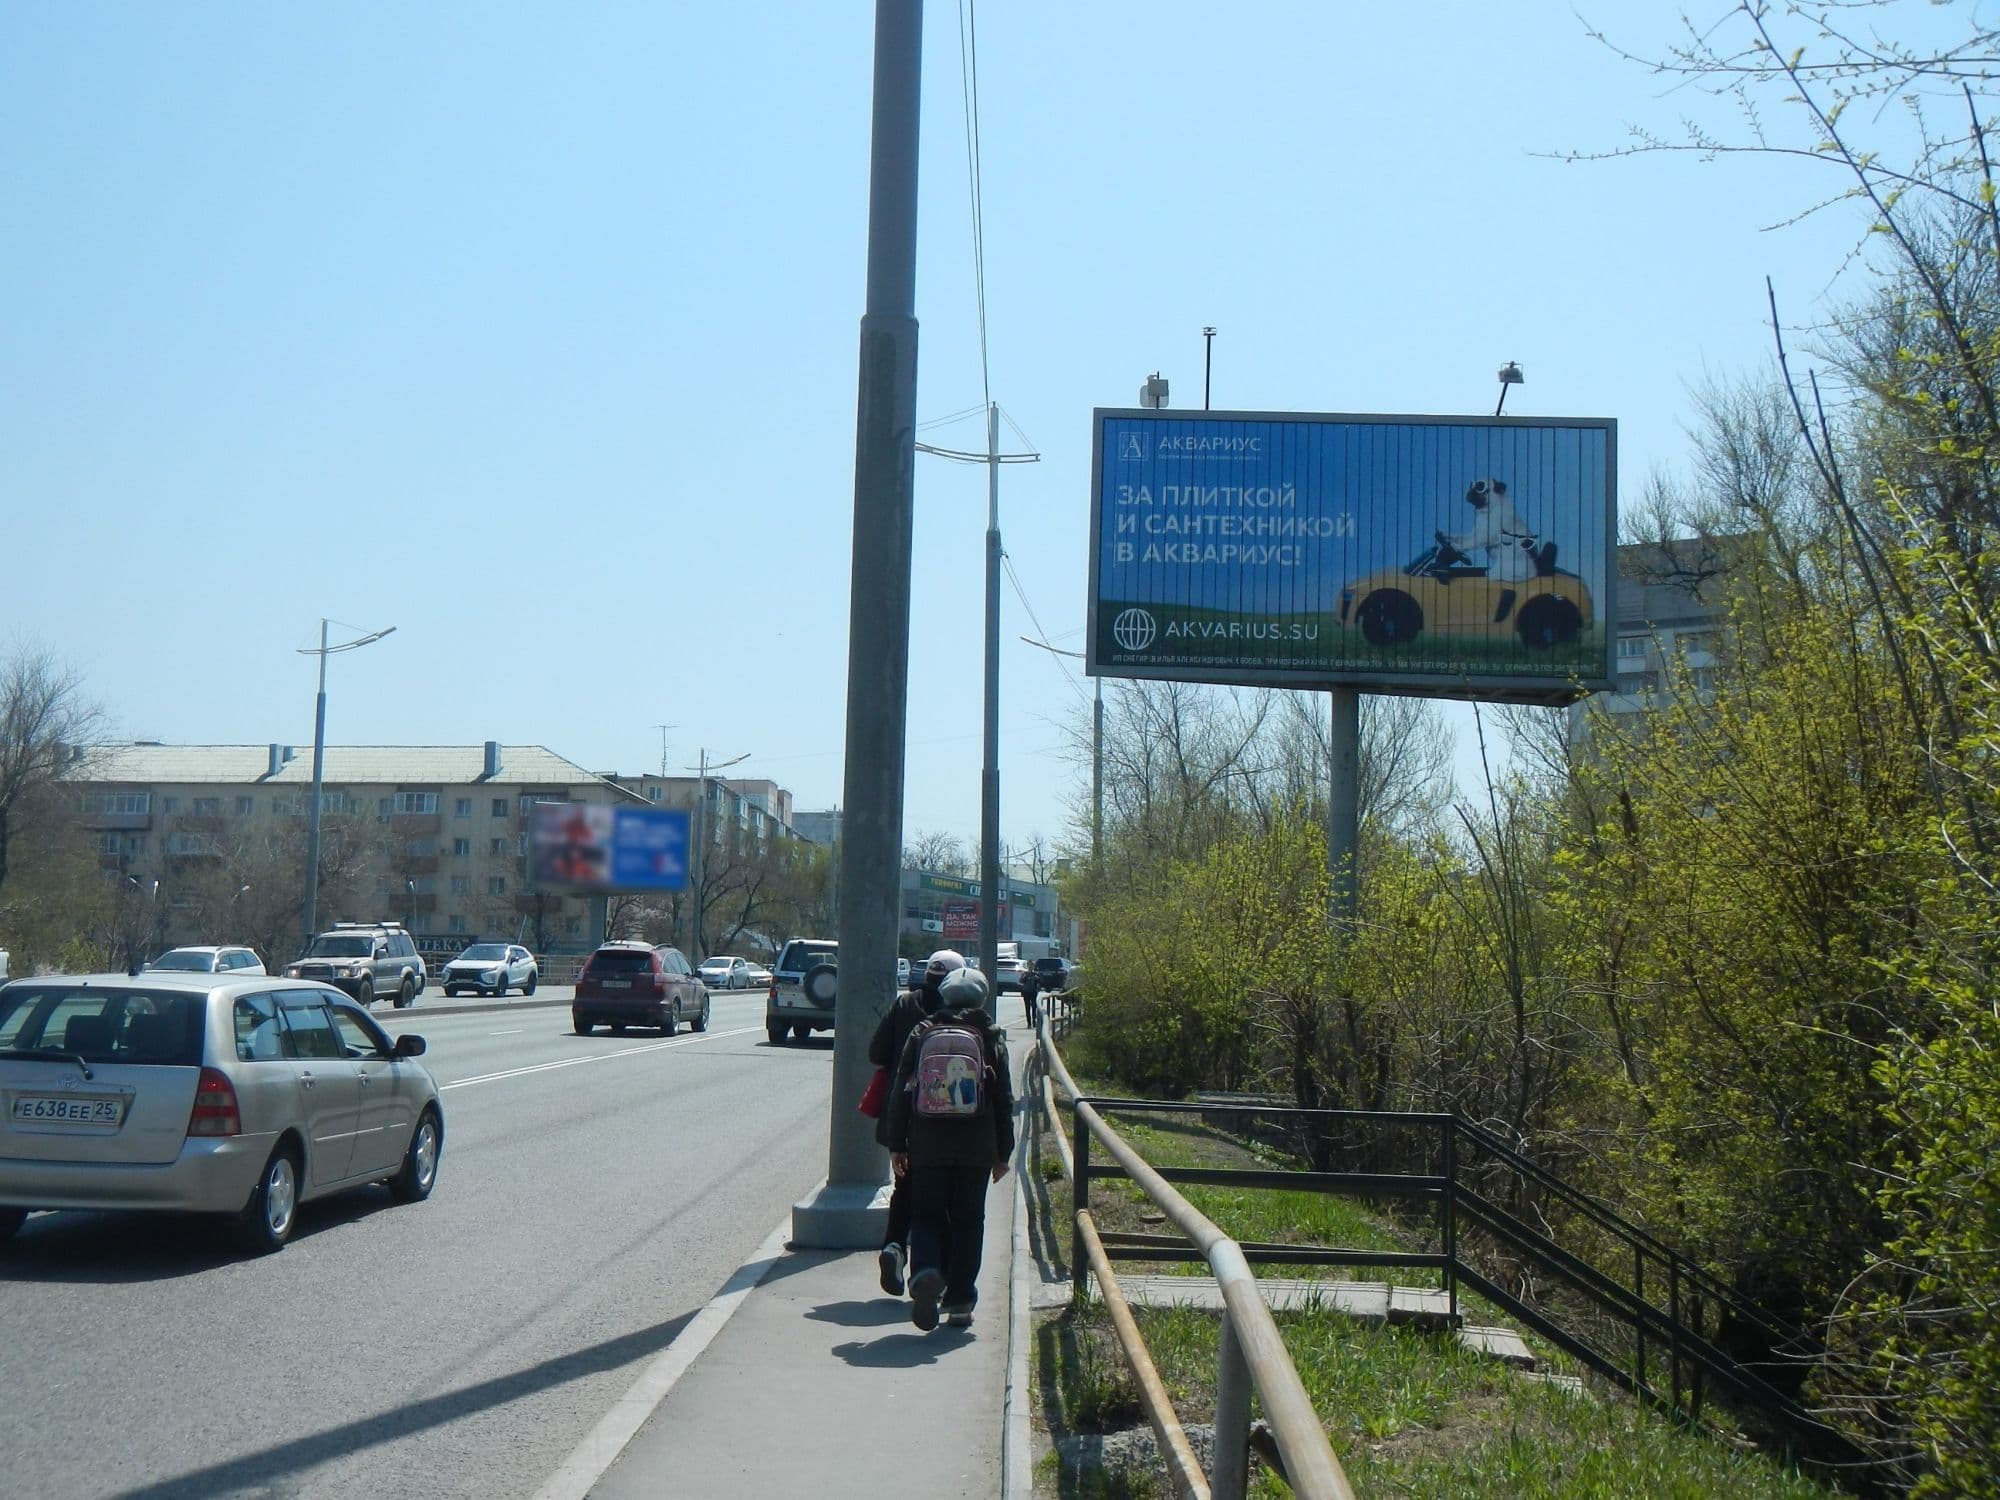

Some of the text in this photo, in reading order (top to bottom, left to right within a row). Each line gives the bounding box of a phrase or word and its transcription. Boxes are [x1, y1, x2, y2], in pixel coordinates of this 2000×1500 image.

[1159, 436, 1261, 451] АКВАРИУС
[1117, 482, 1296, 508] ЗА ПЛИТКОЙ
[1117, 512, 1356, 538] И САНТЕХНИКОЙ
[1117, 542, 1301, 566] В АКВАРИУС!
[1165, 620, 1319, 640] AKVARIUS.SU
